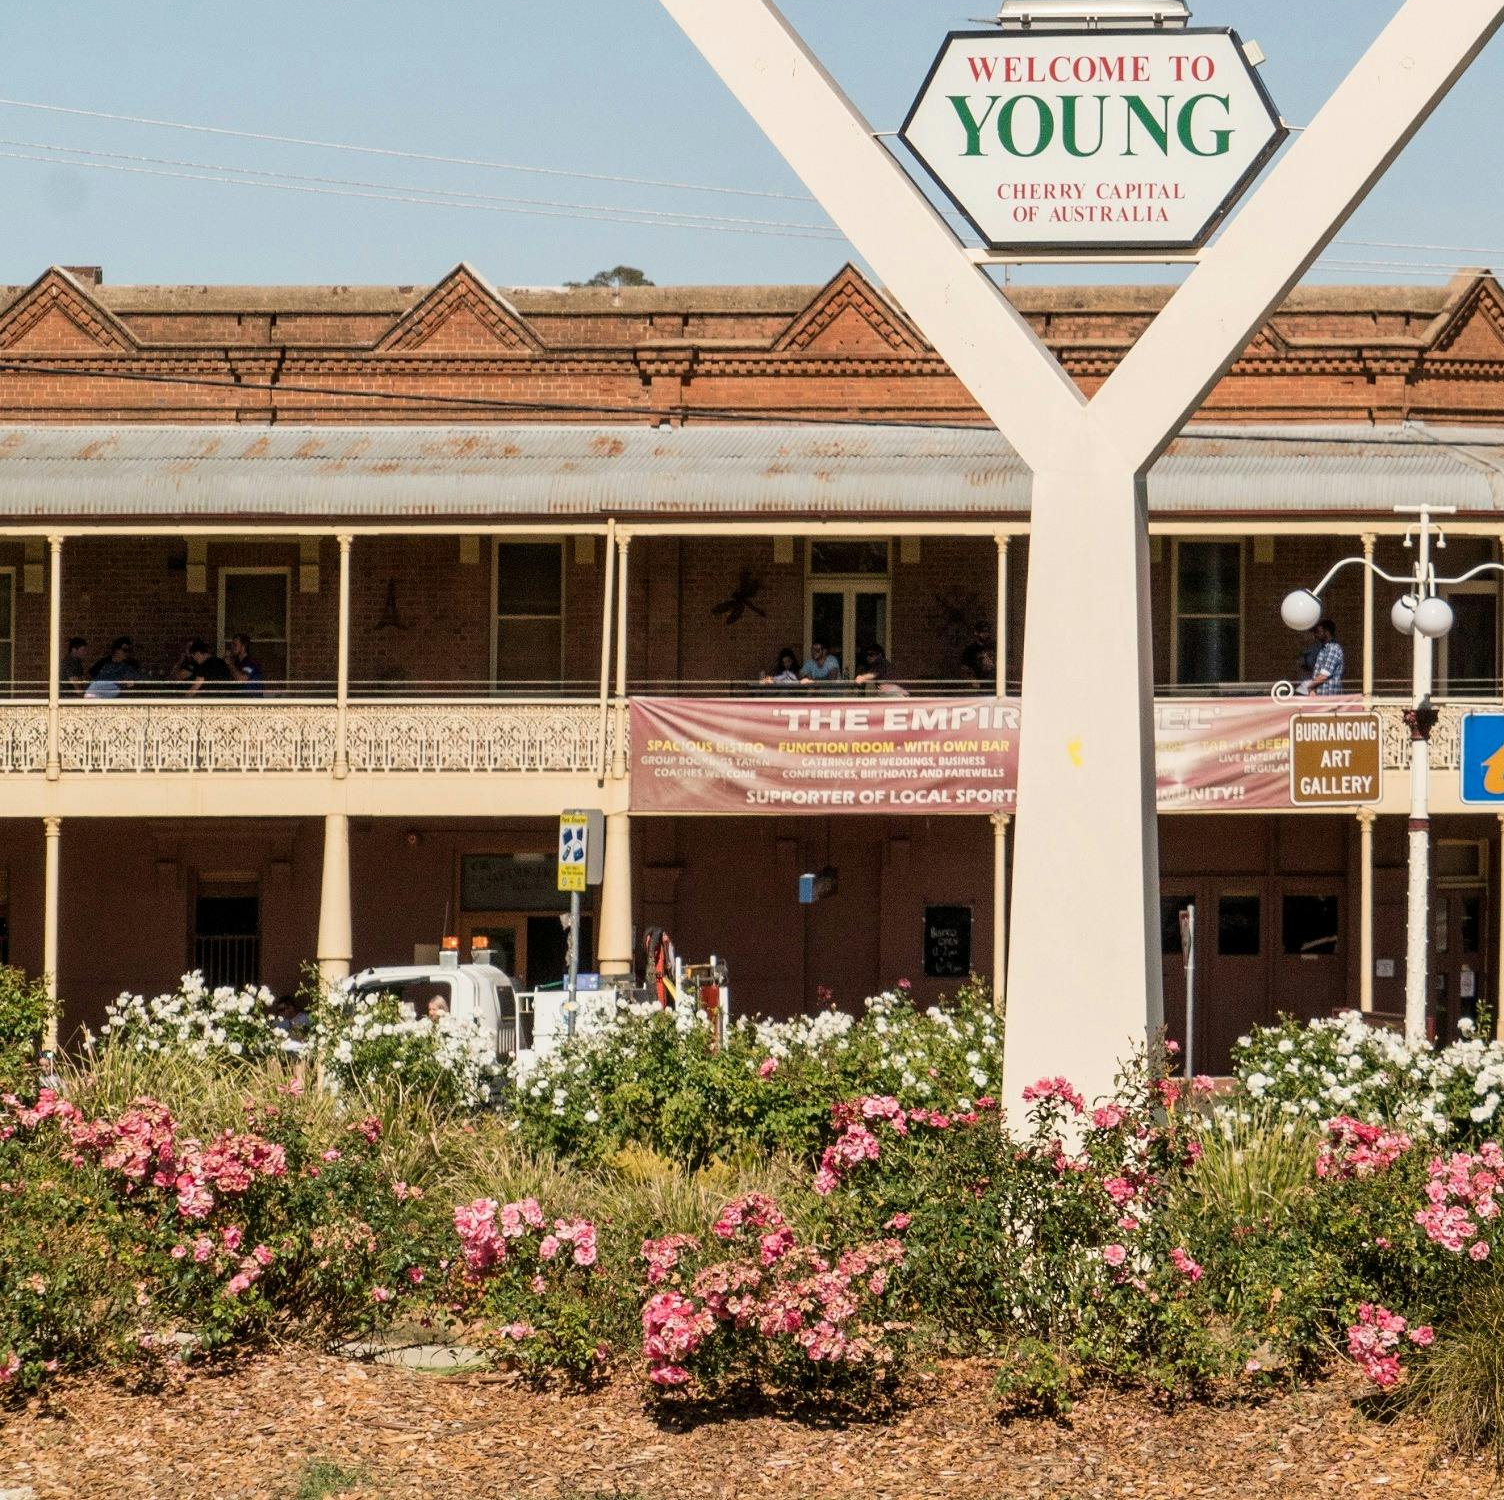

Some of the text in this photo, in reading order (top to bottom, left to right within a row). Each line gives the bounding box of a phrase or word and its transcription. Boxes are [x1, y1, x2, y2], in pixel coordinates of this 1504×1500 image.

[967, 55, 1215, 83] WELCOME TO
[945, 93, 1235, 158] YOUNG
[997, 182, 1185, 200] CHERRY CAPITAL
[1013, 205, 1169, 222] OF AUSTRALIA
[1295, 721, 1377, 741] BURRANGONG
[647, 740, 765, 753] SPACIOUS BISTRO
[778, 742, 849, 754] FUNCTION
[851, 741, 894, 754] ROOM
[904, 741, 940, 753] WITH
[943, 741, 978, 753] OWN
[981, 740, 1010, 752] BAR
[641, 755, 676, 766] GROUP
[801, 757, 853, 767] CATERING
[855, 757, 877, 767] FOR
[938, 756, 986, 766] BUSINESS
[1320, 749, 1352, 768] ART
[654, 768, 703, 778] COACHES
[782, 768, 1005, 780] CONFERENCES, BIRTHDAYS AND FAREWELLS
[1300, 775, 1373, 795] GALLERY
[746, 788, 855, 804] SUPPORTER
[859, 789, 886, 804] OF
[889, 789, 952, 804] LOCAL
